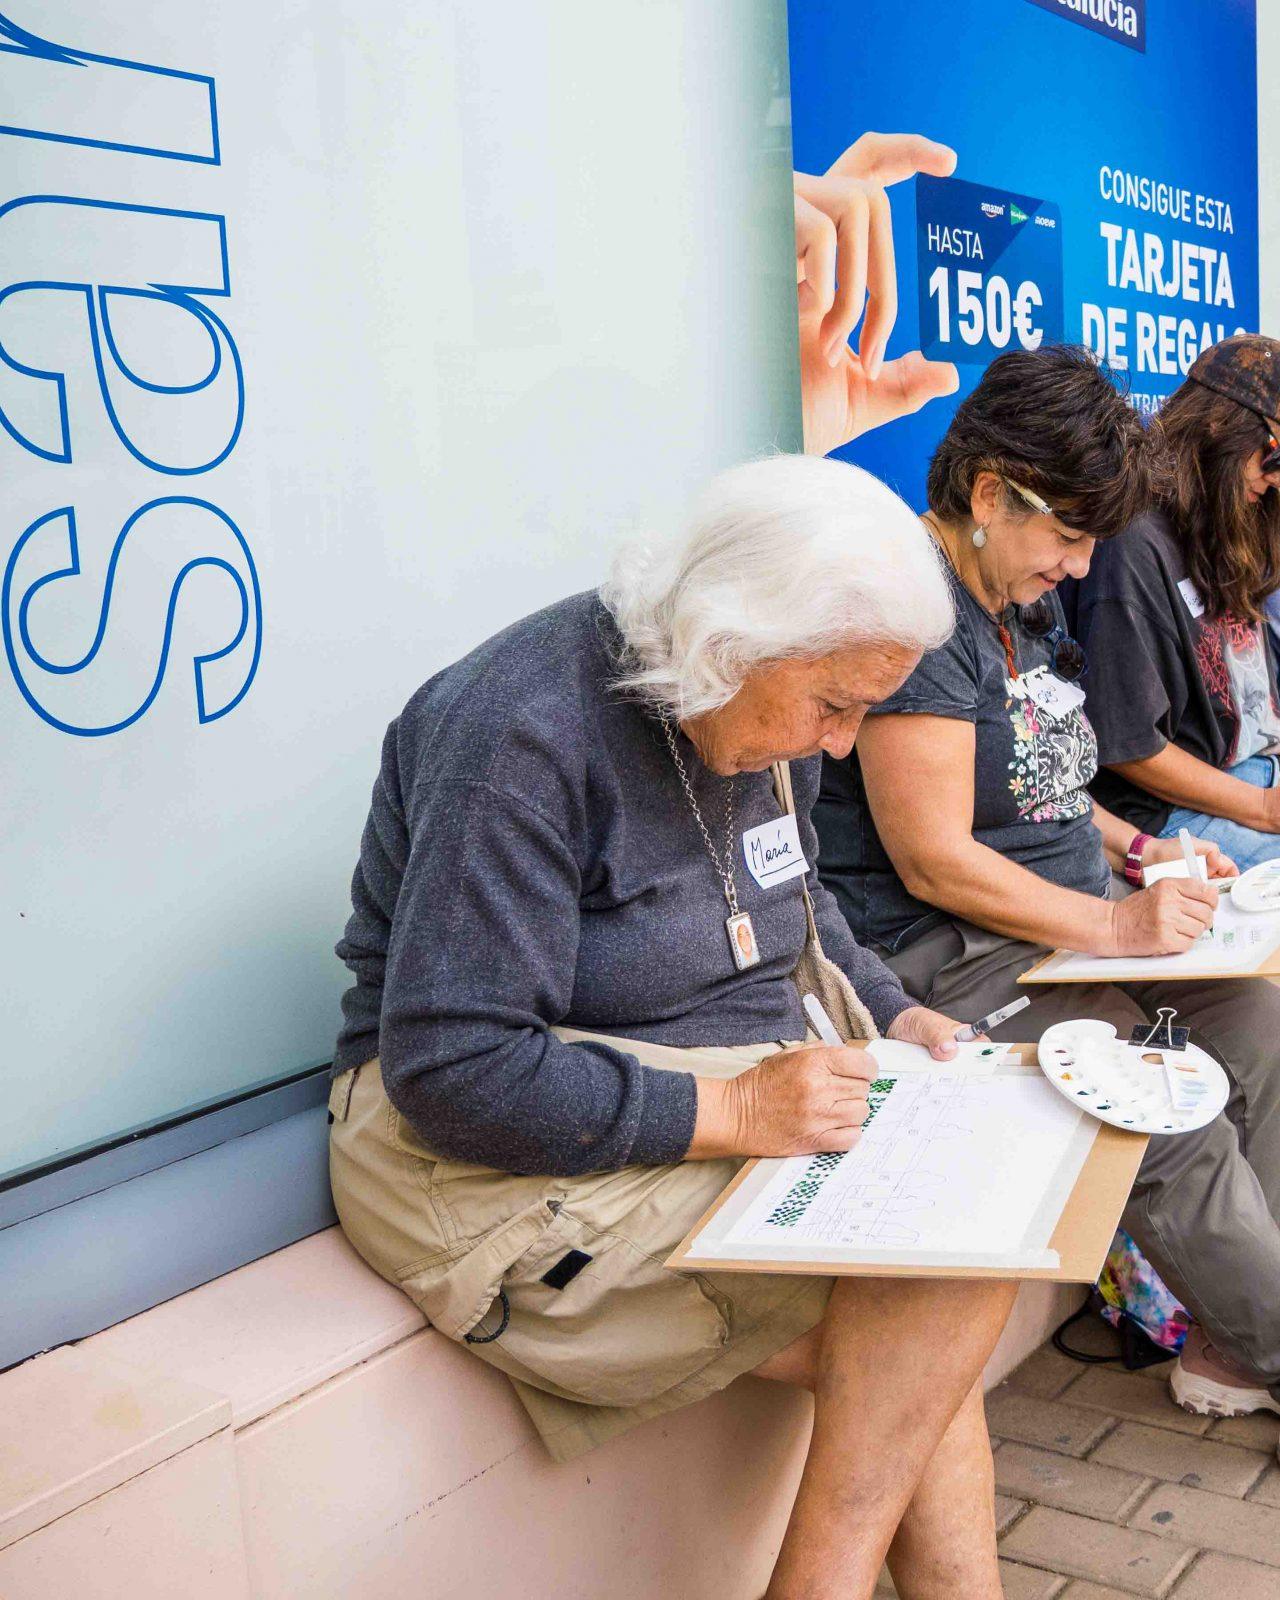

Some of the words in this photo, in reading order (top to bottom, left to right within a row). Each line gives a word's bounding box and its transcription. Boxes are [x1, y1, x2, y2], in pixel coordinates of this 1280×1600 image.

[981, 202, 1005, 216] amazon
[1100, 166, 1191, 223] CONSIGUE
[1195, 195, 1234, 235] ESTA
[927, 222, 984, 260] HASTA
[1100, 221, 1236, 309] TARJETA
[929, 266, 1044, 352] 150€
[1082, 302, 1129, 370] DE
[1136, 312, 1247, 377] REGA
[751, 829, 793, 870] María
